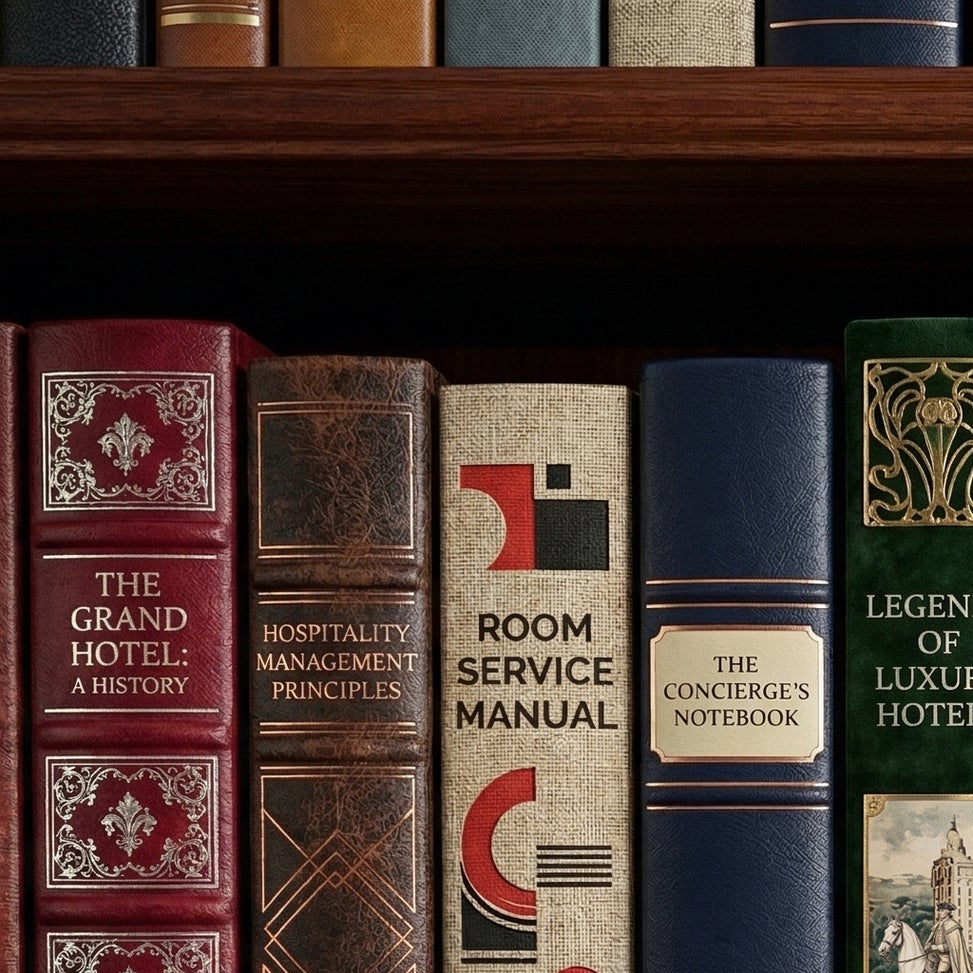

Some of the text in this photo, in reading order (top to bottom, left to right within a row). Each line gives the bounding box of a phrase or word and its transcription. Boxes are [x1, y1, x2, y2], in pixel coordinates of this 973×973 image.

[95, 572, 161, 597] THE
[71, 606, 188, 631] GRAND
[478, 613, 592, 642] ROOM
[263, 623, 410, 643] HOSPITALITY
[917, 630, 960, 655] OF
[71, 641, 188, 666] HOTEL:
[256, 652, 418, 672] MANAGEMENT
[713, 656, 758, 673] THE
[457, 656, 614, 686] SERVICE
[71, 676, 189, 694] A HISTORY
[272, 681, 402, 700] PRINCIPLES
[456, 700, 619, 730] MANUAL
[674, 709, 800, 727] NOTEBOOK
